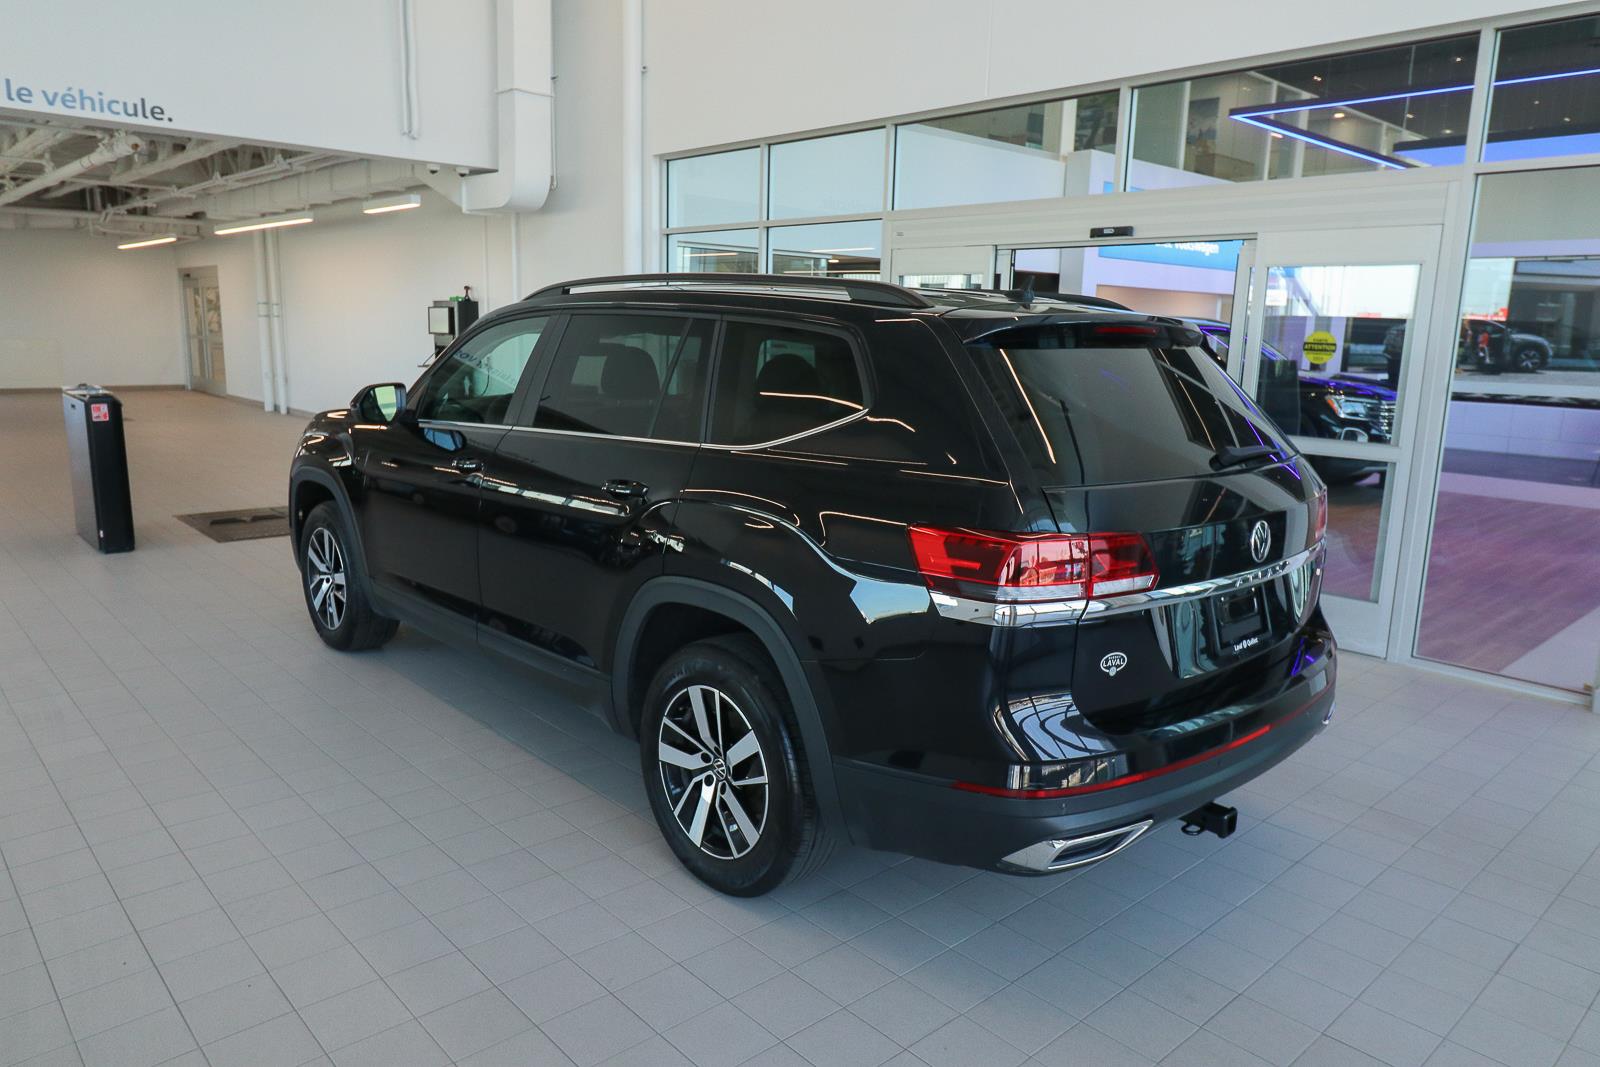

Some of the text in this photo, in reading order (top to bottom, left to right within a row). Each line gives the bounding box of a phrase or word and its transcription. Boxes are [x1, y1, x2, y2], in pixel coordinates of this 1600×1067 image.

[5, 78, 174, 122] le véhicule.
[1103, 657, 1123, 667] LAVAL
